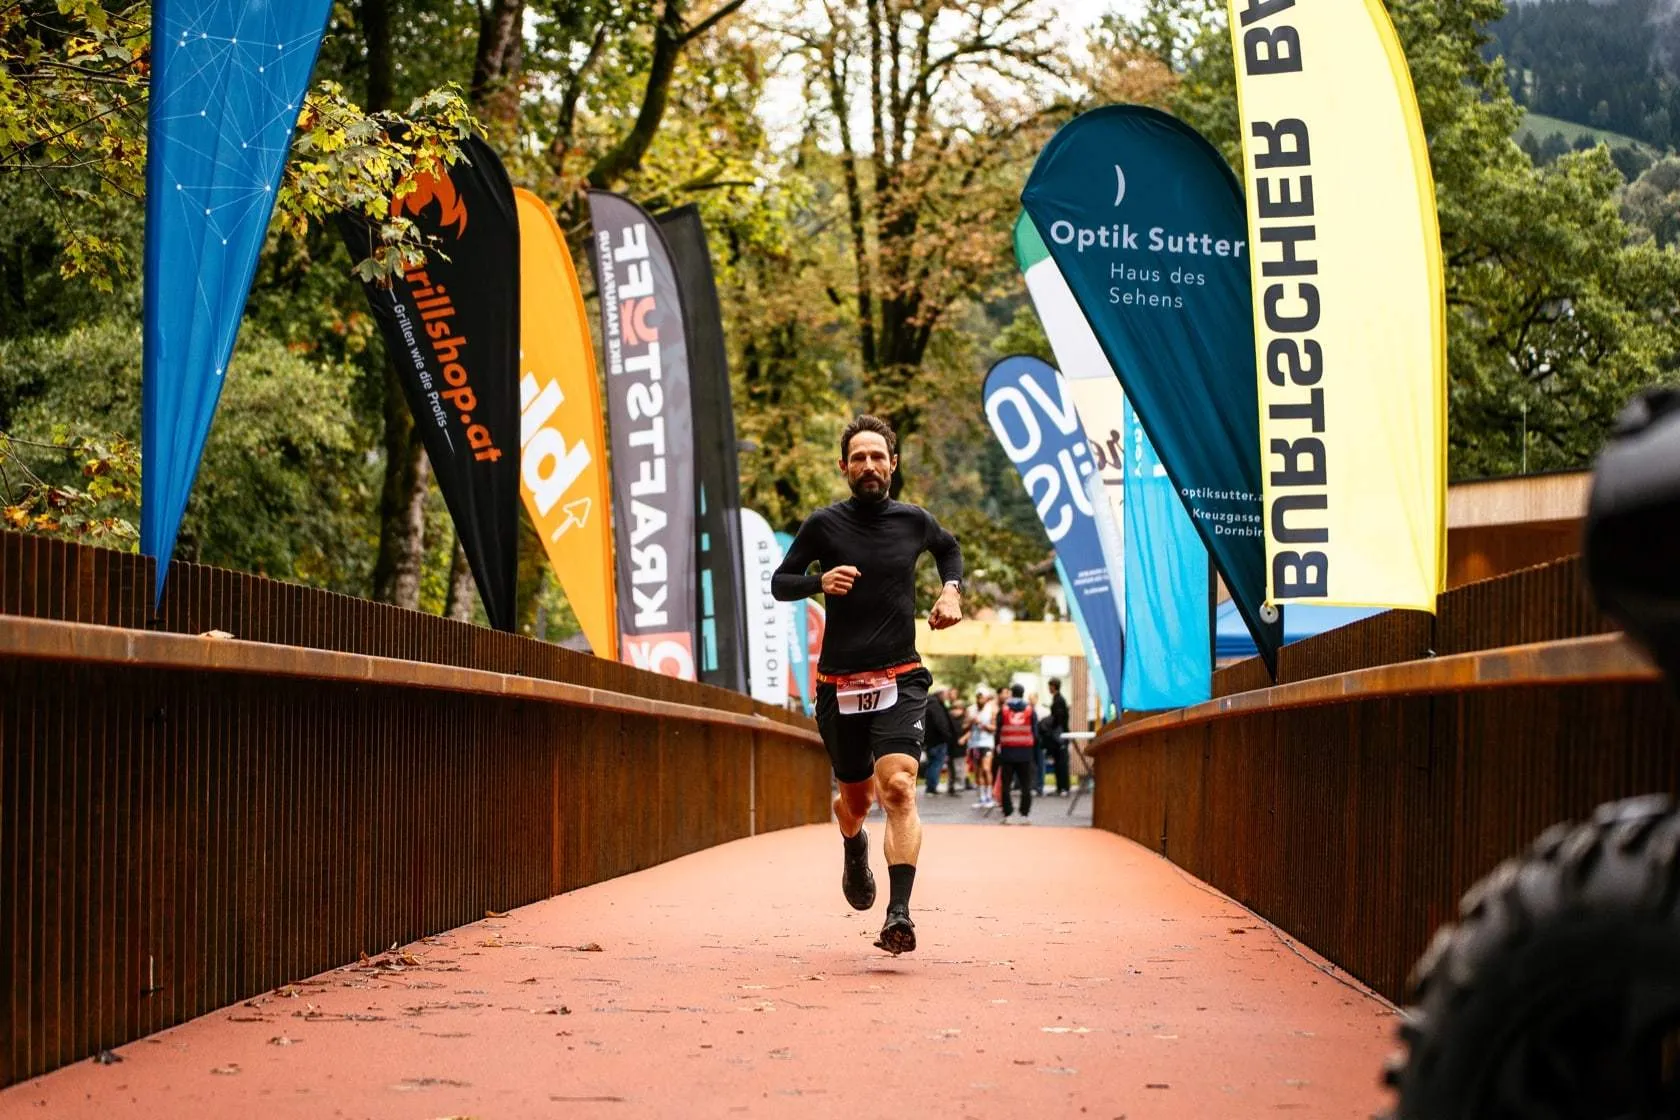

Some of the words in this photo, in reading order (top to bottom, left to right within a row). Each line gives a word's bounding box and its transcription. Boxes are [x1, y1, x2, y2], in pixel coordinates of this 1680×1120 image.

[1049, 219, 1139, 252] Optik
[1148, 226, 1246, 258] Sutter
[1110, 262, 1161, 282] Haus
[1169, 266, 1206, 286] des
[1109, 287, 1183, 309] Sehens
[393, 303, 417, 347] Grillen
[410, 346, 426, 370] wie
[418, 369, 433, 391] die
[427, 391, 448, 428] Profis
[1192, 507, 1261, 524] Kreuzgasse
[856, 690, 882, 712] 137
